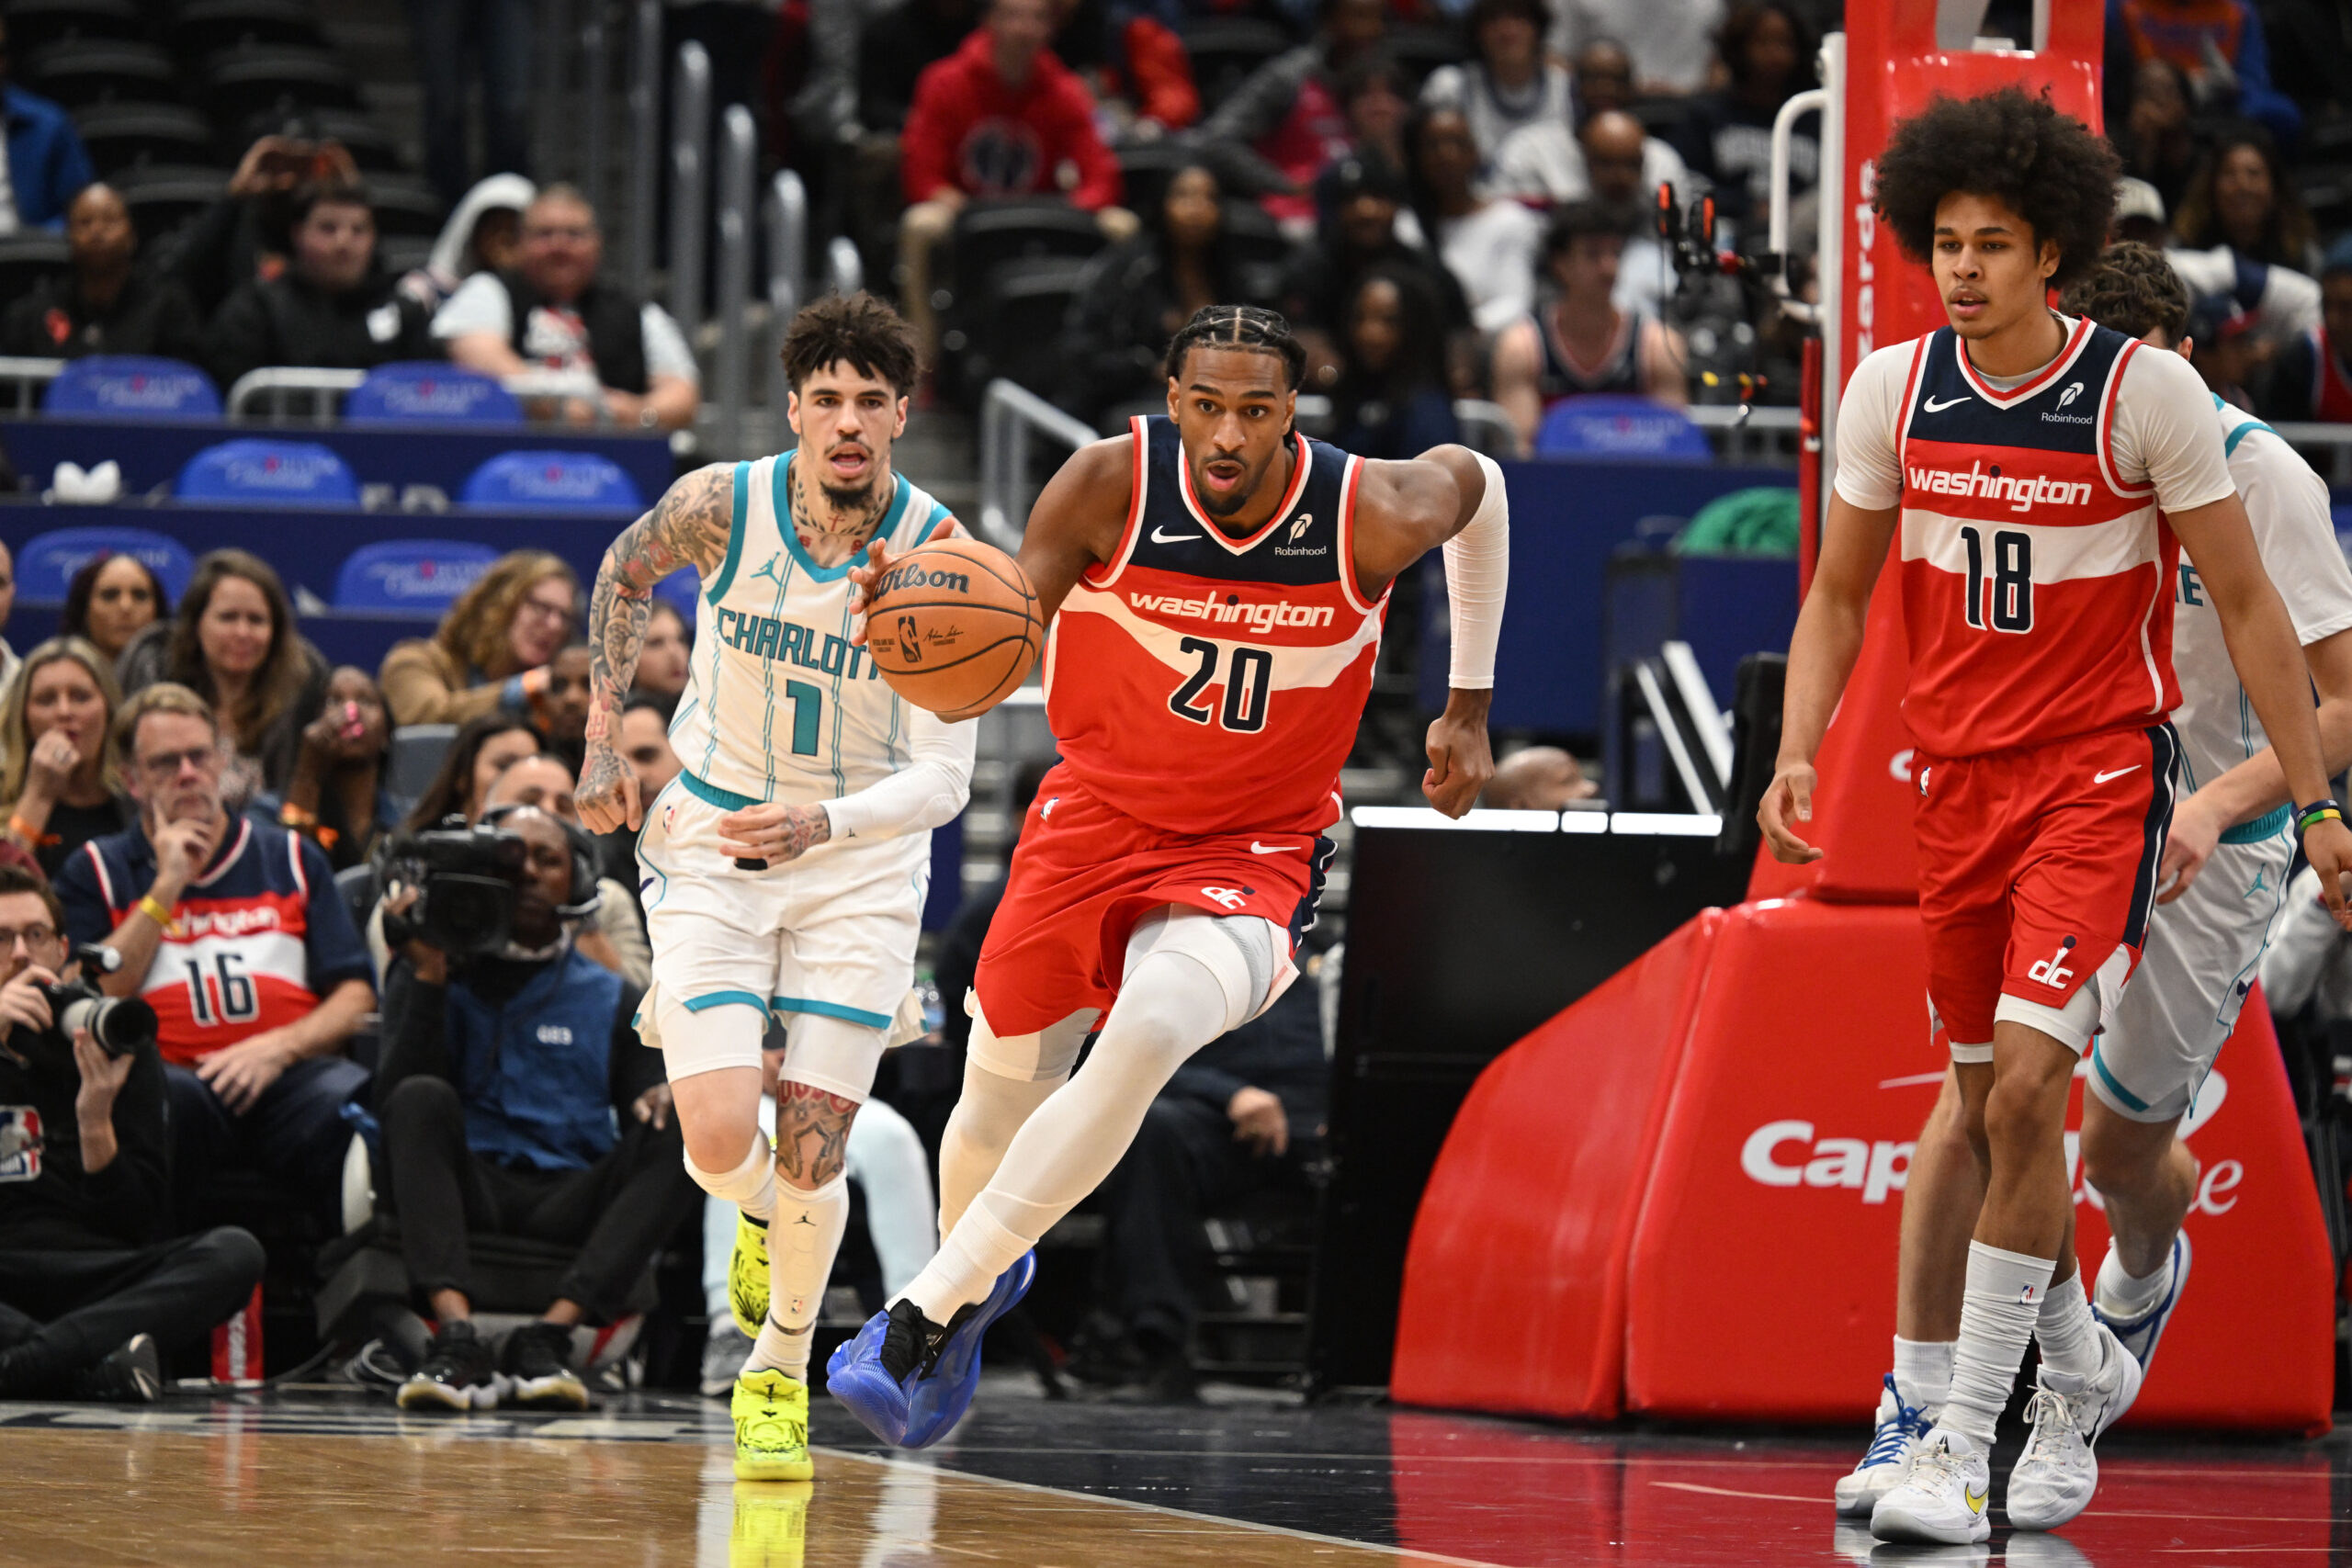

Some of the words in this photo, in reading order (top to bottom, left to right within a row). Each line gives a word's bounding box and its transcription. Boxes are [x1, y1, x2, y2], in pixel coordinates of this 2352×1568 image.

[2041, 412, 2093, 425] Robinhood
[1908, 459, 2092, 513] washington
[1274, 546, 1328, 557] Robinhood
[873, 562, 970, 603] Wilson
[1960, 524, 2034, 635] 18
[1130, 590, 1335, 634] washington
[1167, 637, 1273, 735] 20
[786, 678, 822, 757] 1
[184, 951, 261, 1028] 16
